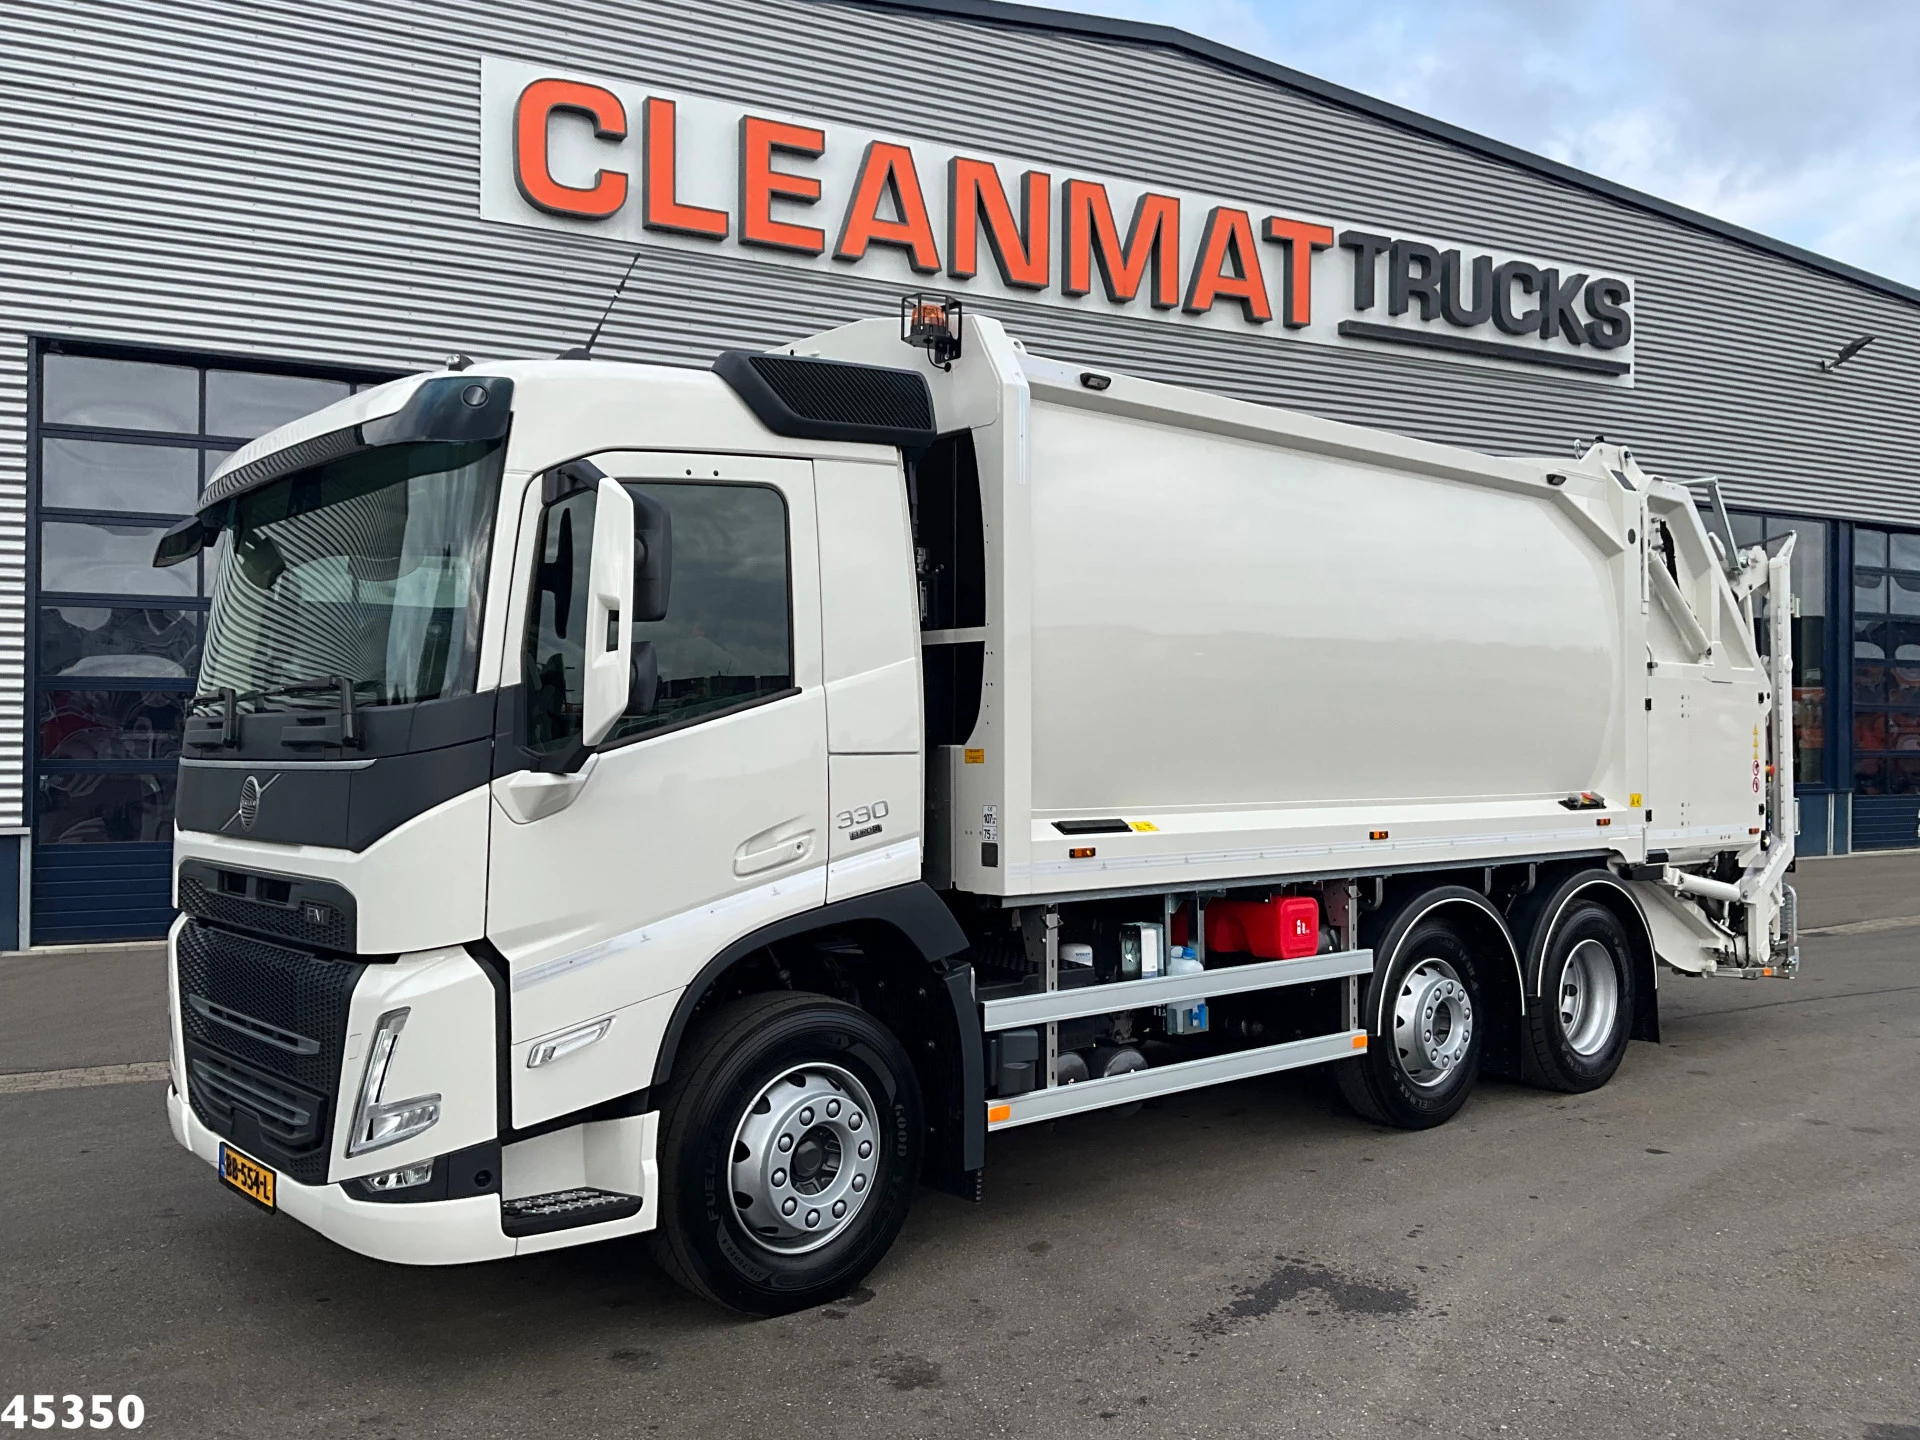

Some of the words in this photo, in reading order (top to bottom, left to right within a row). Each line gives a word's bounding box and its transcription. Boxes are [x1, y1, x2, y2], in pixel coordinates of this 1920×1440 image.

[513, 78, 1334, 328] CLEANMAT
[1339, 230, 1632, 349] TRUCKS
[836, 800, 889, 829] 330
